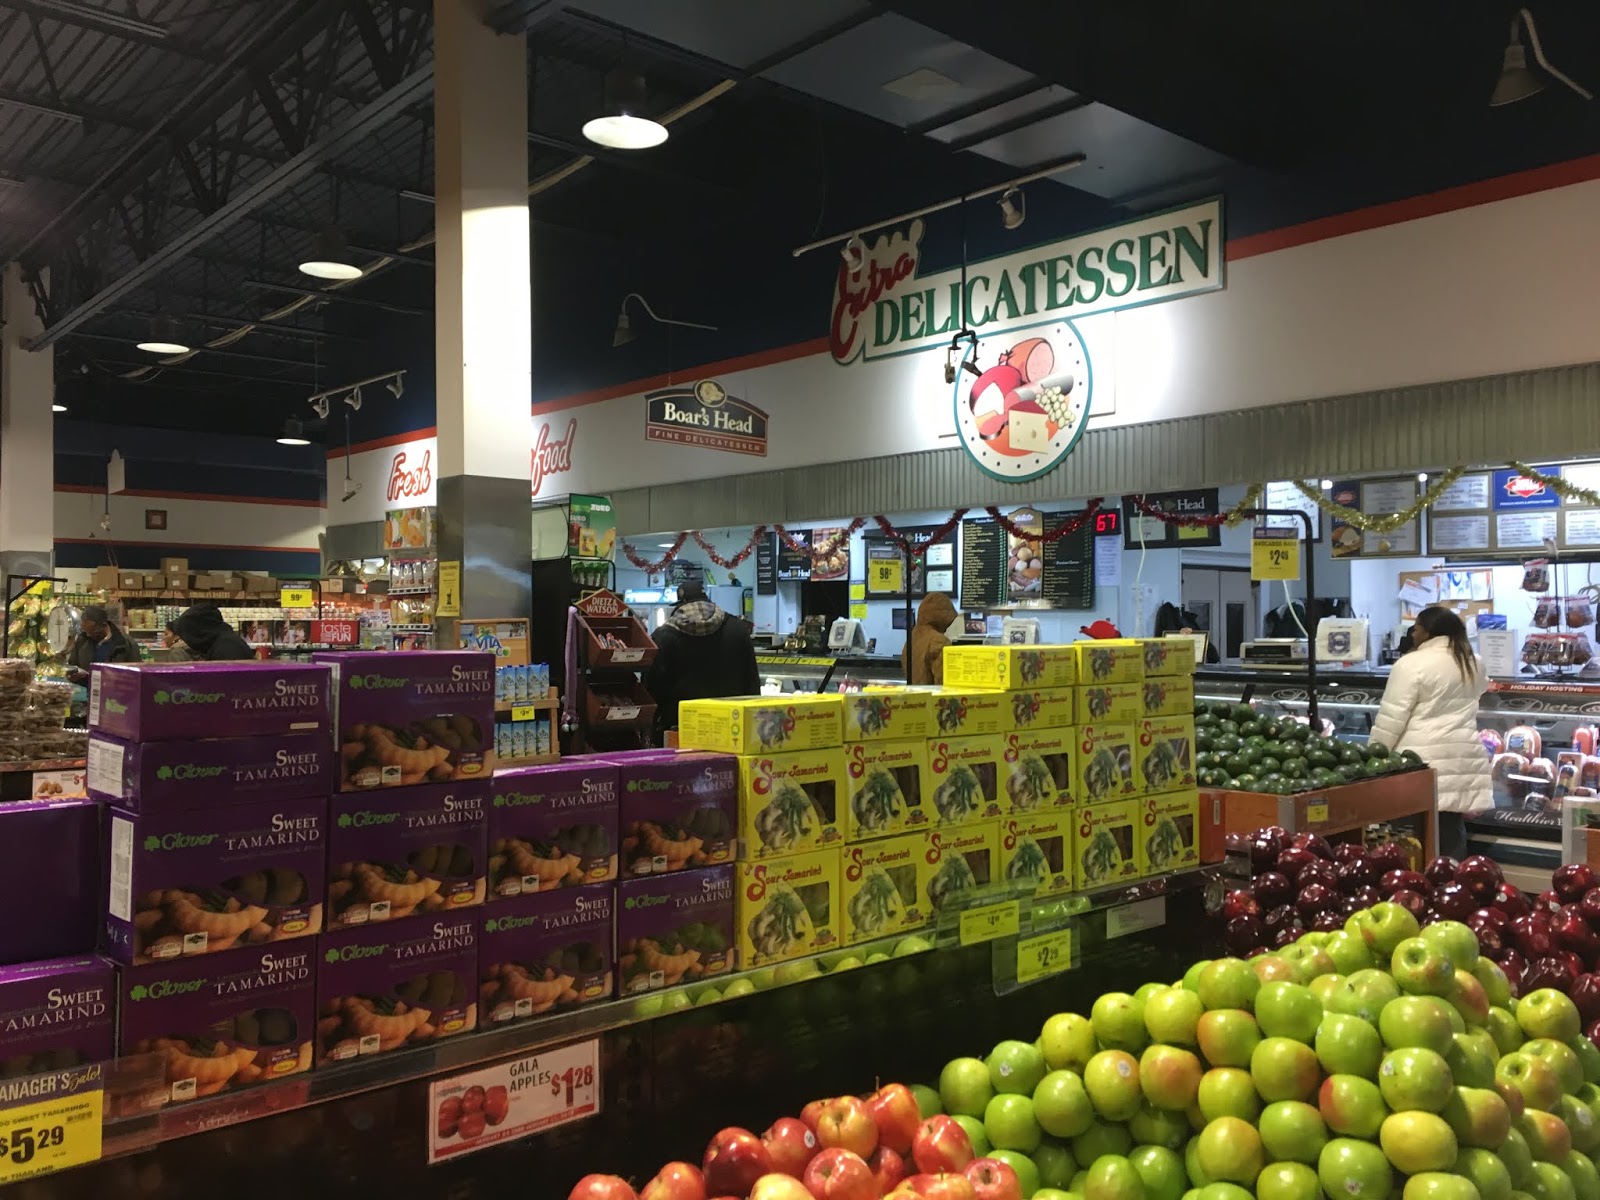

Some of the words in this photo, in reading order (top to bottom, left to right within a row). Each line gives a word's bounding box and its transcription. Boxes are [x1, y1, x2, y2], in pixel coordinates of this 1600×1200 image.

[873, 218, 1212, 348] DELICATESSEN
[664, 402, 710, 427] Boar's
[714, 410, 753, 434] Head
[655, 430, 680, 440] FINE
[685, 434, 760, 452] DELICATESSEN
[530, 418, 578, 497] food
[387, 450, 432, 502] Fresh
[1177, 497, 1205, 511] Head
[1096, 513, 1117, 532] 67
[586, 604, 618, 614] WATSON
[591, 597, 613, 606] DIETZ
[320, 622, 352, 634] taste
[331, 633, 352, 642] FUN
[475, 635, 502, 652] VITA
[364, 674, 410, 690] Clover
[452, 665, 488, 681] SWEET
[170, 688, 225, 705] Clover
[275, 679, 318, 697] SWEET
[414, 681, 491, 695] TAMARIND
[1510, 684, 1545, 692] HOLIDAY
[231, 694, 319, 710] TAMARIND
[1497, 697, 1579, 713] Dietz
[782, 707, 806, 732] Sour
[808, 710, 835, 721] Tamarind
[276, 749, 318, 767] SWEET
[849, 745, 877, 779] Sour
[879, 750, 912, 763] Tamarind
[932, 743, 959, 774] Sour
[173, 765, 227, 781] Clover
[233, 763, 320, 782] TAMARIND
[752, 759, 786, 795] Sour
[788, 763, 829, 778] Tamarind
[582, 779, 614, 794] SWEET
[444, 795, 482, 812] SWEET
[505, 792, 546, 807] Clover
[550, 791, 615, 808] TAMARIND
[271, 814, 318, 832] SWEET
[352, 811, 401, 828] Clover
[405, 810, 484, 828] TAMARIND
[1493, 810, 1555, 826] Healthier
[161, 831, 219, 850] Clover
[225, 829, 320, 850] TAMARIND
[926, 833, 951, 864] Sour
[846, 848, 875, 882] Sour
[876, 849, 911, 864] Tamarind
[702, 879, 730, 894] SWEET
[746, 865, 781, 902] Sour
[782, 864, 822, 883] Tamarind
[575, 897, 608, 913] SWEET
[636, 894, 671, 908] Clover
[675, 889, 732, 908] TAMARIND
[498, 914, 539, 931] Clover
[543, 908, 610, 930] TAMARIND
[433, 922, 472, 940] SWEET
[340, 944, 390, 961] Clover
[394, 935, 474, 959] TAMARIND
[261, 954, 308, 974] SWEET
[149, 978, 207, 999] Clover
[214, 967, 309, 996] TAMARIND
[47, 988, 103, 1010] SWEET
[0, 1003, 105, 1032] AMARIND
[509, 1058, 539, 1077] GALA
[0, 1072, 69, 1102] ANAGER'S
[69, 1064, 101, 1092] Sale!
[509, 1070, 551, 1093] APPLES
